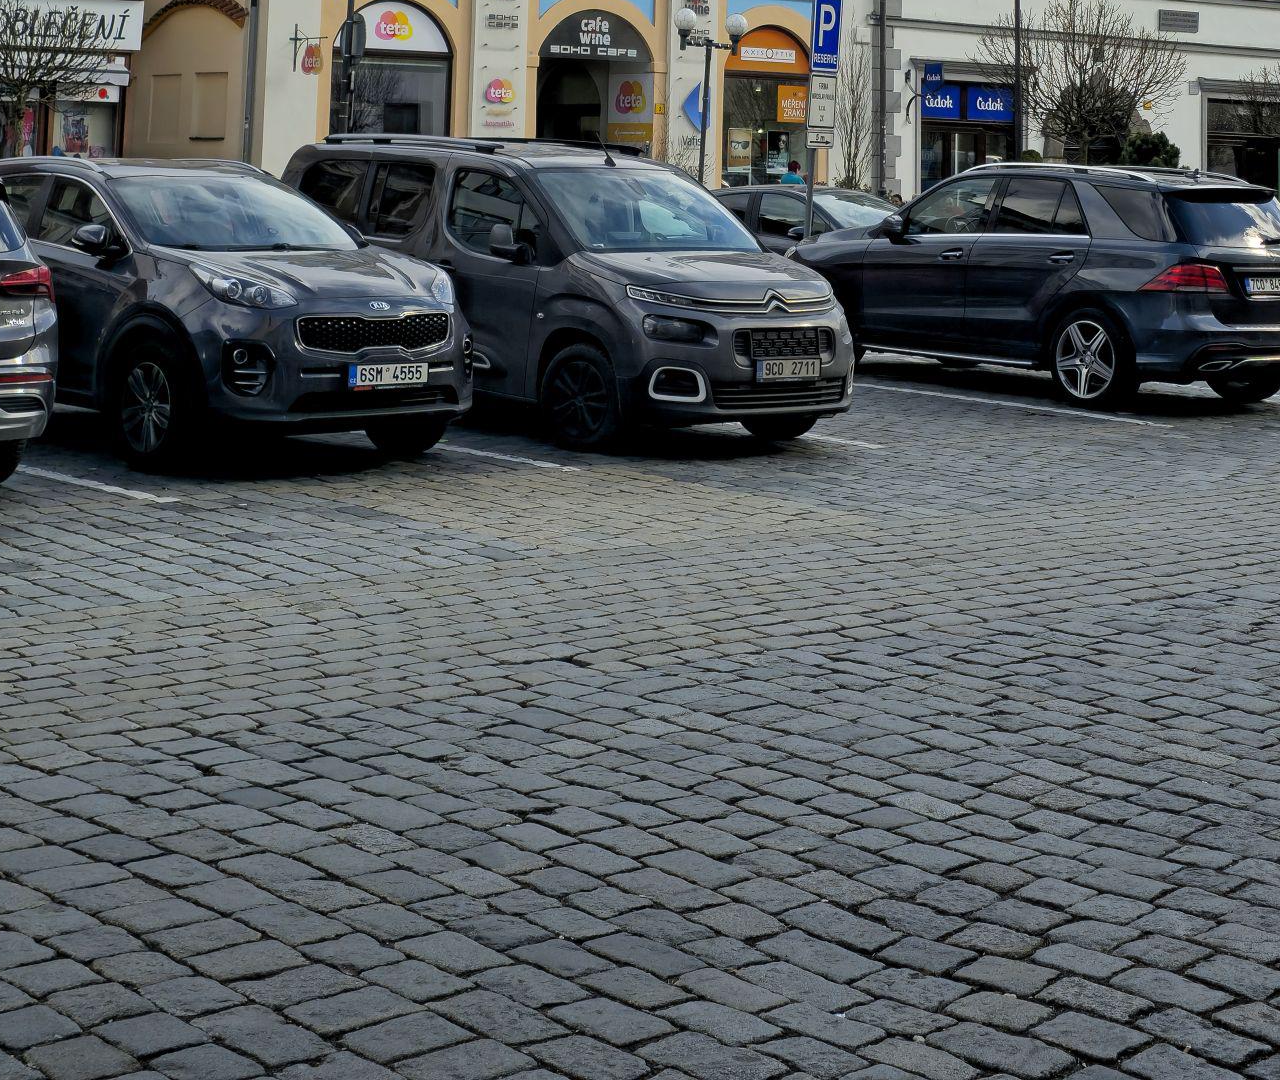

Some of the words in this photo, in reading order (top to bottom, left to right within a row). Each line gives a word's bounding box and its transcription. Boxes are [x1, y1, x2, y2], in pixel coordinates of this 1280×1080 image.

[380, 22, 409, 35] teta
[581, 16, 610, 33] cafe
[818, 3, 837, 47] P
[579, 32, 611, 46] wine
[304, 55, 321, 68] teta
[490, 87, 513, 98] teta
[619, 94, 642, 108] teta
[781, 98, 807, 109] MĚŘENÍ
[925, 93, 953, 109] Čedok
[976, 96, 1004, 112] Čedok
[783, 108, 806, 118] ZRAKU
[372, 302, 389, 310] KIA
[359, 367, 383, 383] 6SM
[392, 365, 423, 381] 4555
[791, 361, 816, 375] 2711
